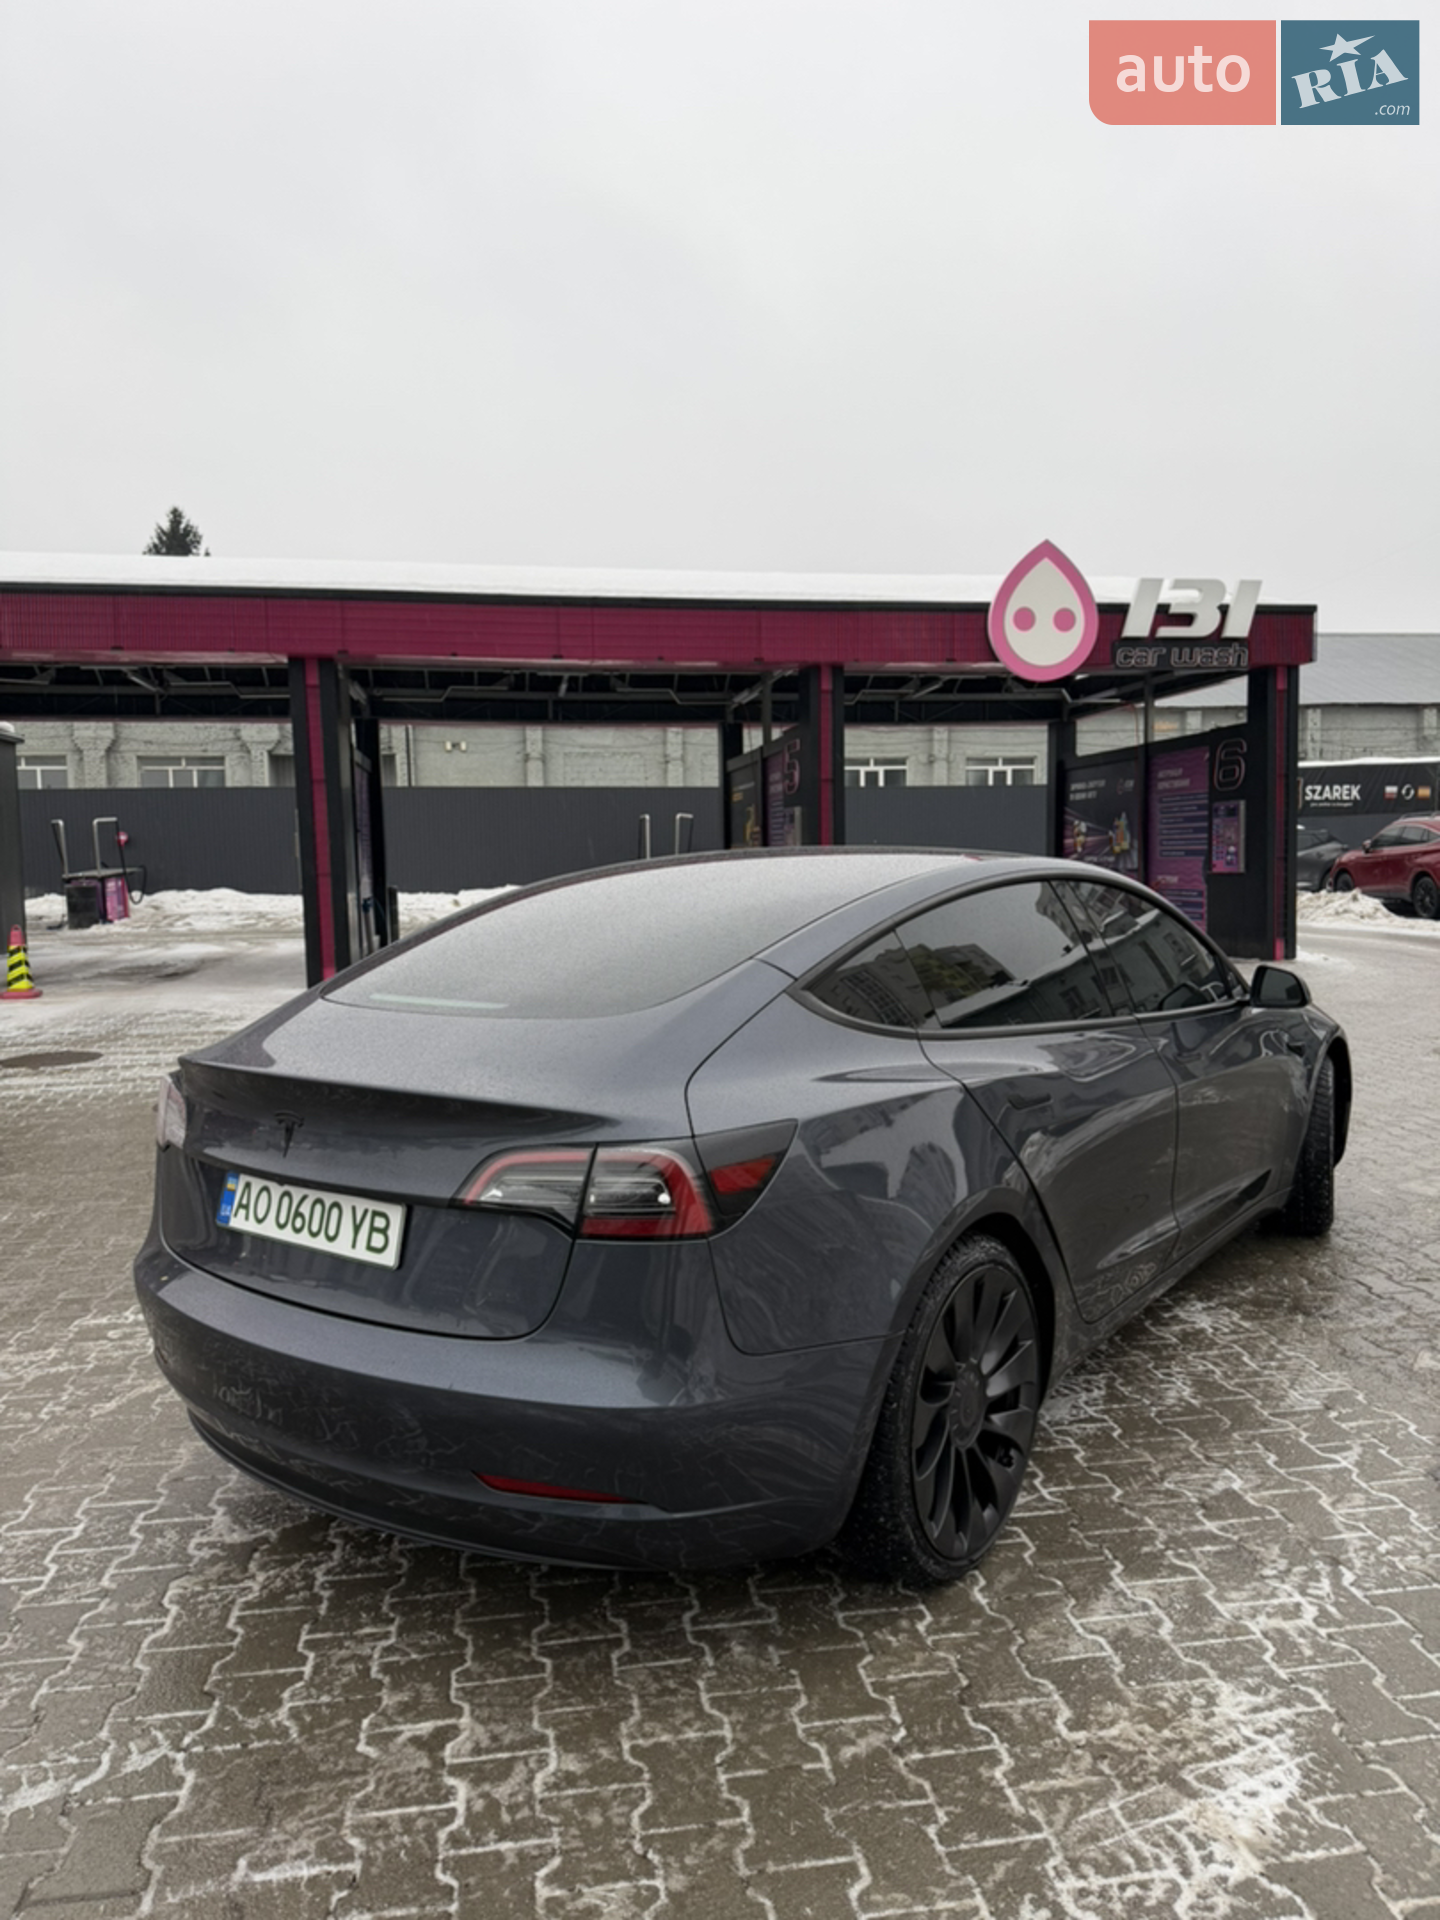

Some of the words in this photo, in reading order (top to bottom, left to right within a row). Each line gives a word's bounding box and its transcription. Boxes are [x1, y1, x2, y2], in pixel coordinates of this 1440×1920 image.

[1116, 647, 1166, 667] car
[1170, 643, 1248, 667] wash
[784, 739, 800, 795] 5
[1213, 738, 1247, 791] 6
[1304, 784, 1361, 801] SZAREK
[233, 1181, 272, 1225] AO
[275, 1190, 343, 1243] 0600
[351, 1205, 391, 1254] YB
